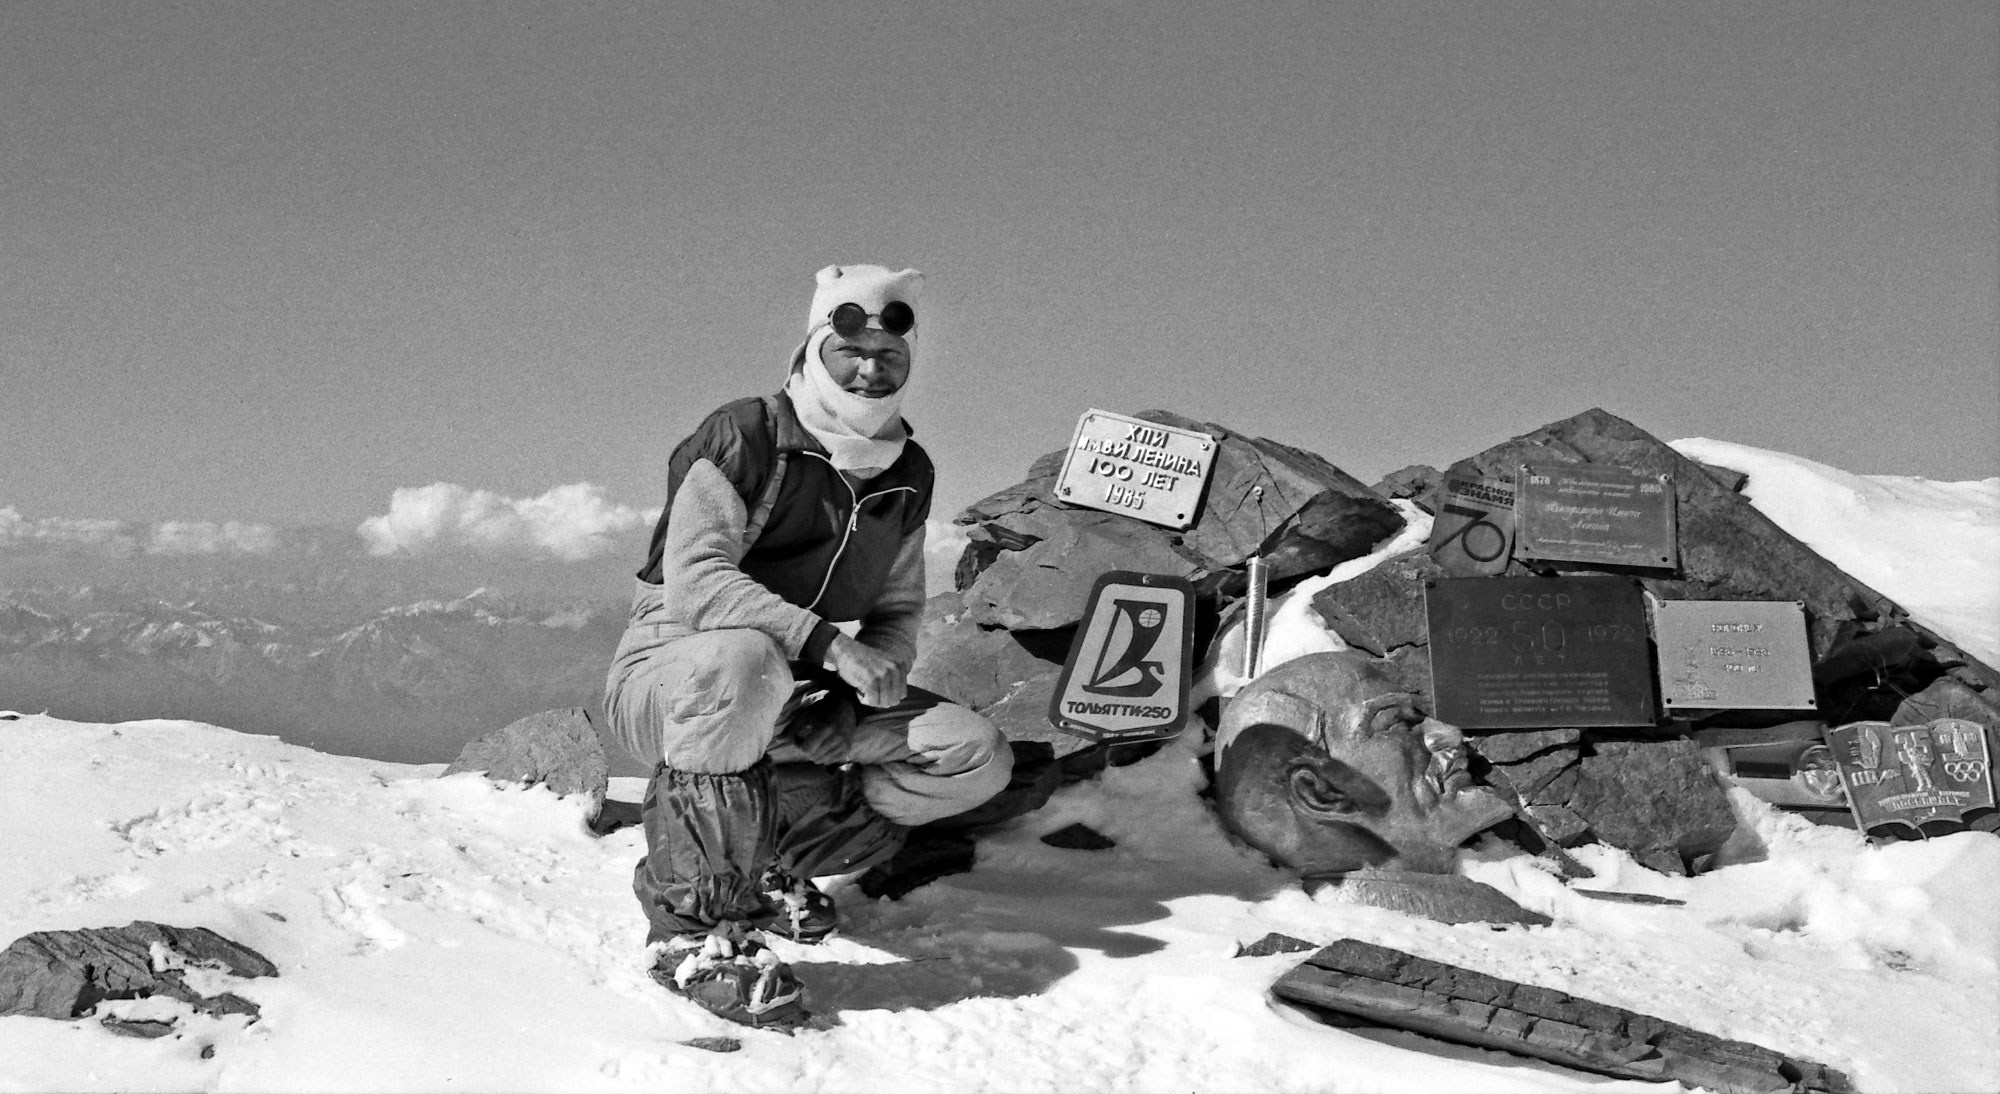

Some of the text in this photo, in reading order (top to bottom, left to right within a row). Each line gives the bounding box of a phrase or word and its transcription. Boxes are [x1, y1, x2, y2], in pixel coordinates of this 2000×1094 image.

[1125, 424, 1170, 449] ХПИ
[1088, 457, 1134, 482] 100
[1141, 471, 1180, 492] ЛЕТ
[1105, 483, 1147, 511] 1985
[1460, 487, 1515, 506] ЗНАМЯ
[1434, 503, 1506, 563] 70
[1501, 592, 1572, 611] СССР
[1448, 626, 1498, 645] 1922
[1512, 619, 1567, 652] 50
[1587, 623, 1636, 644] 1972
